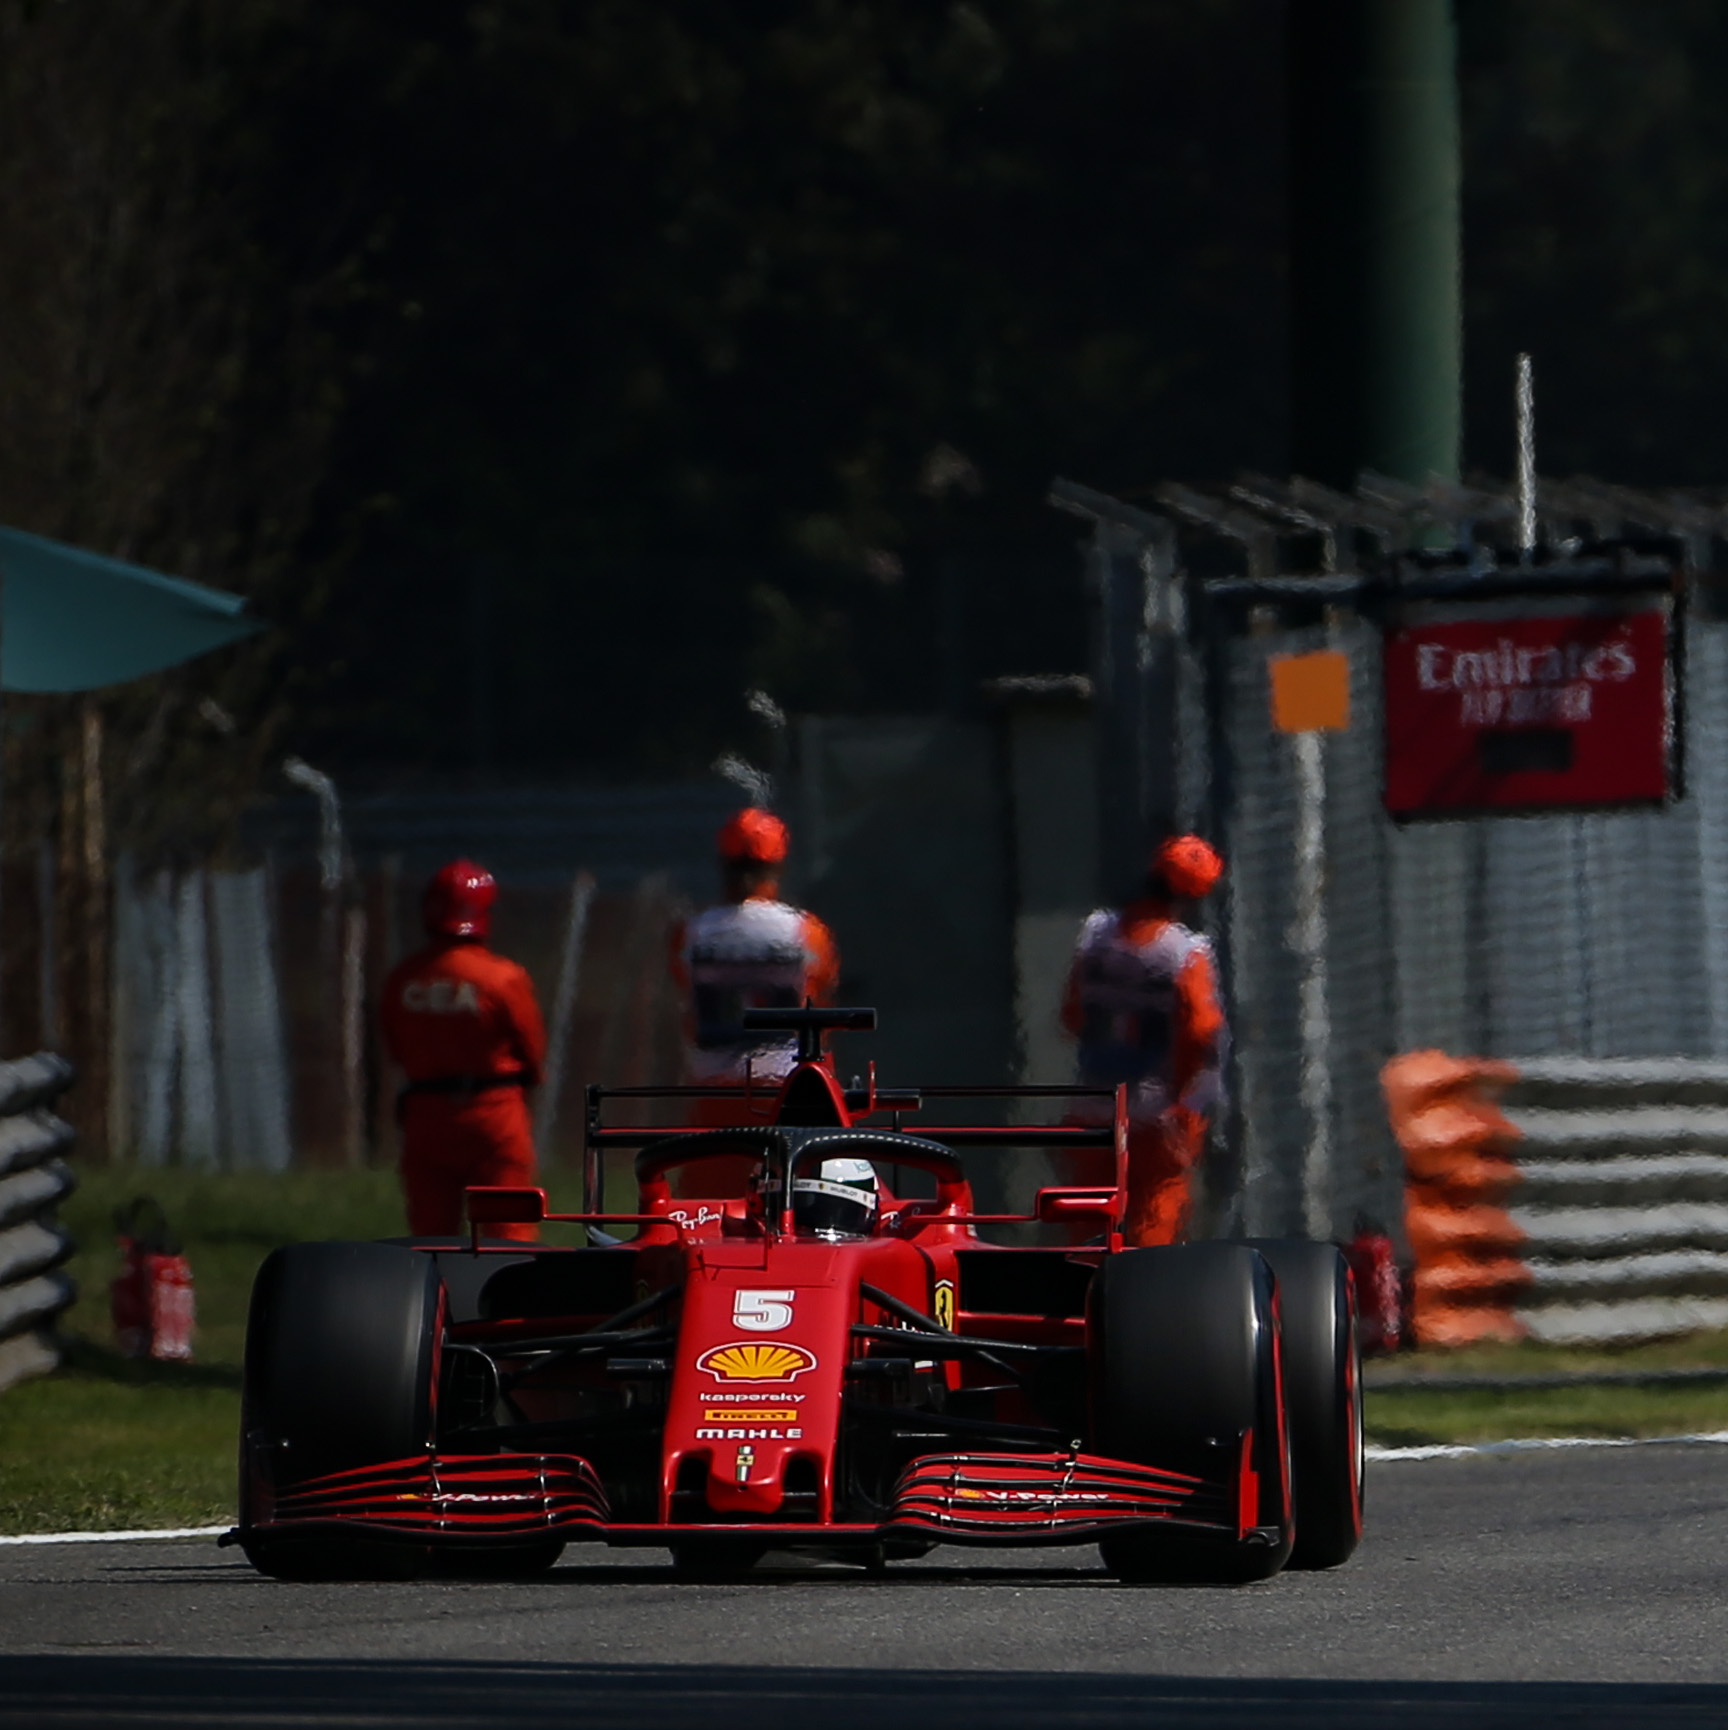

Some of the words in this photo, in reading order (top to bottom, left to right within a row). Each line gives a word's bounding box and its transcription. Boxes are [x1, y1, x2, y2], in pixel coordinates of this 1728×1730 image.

[1415, 637, 1637, 691] Emirates
[667, 1206, 721, 1230] Ray-Ban
[733, 1290, 795, 1332] 5
[700, 1392, 806, 1402] kaspersky
[695, 1427, 803, 1439] MAHLE
